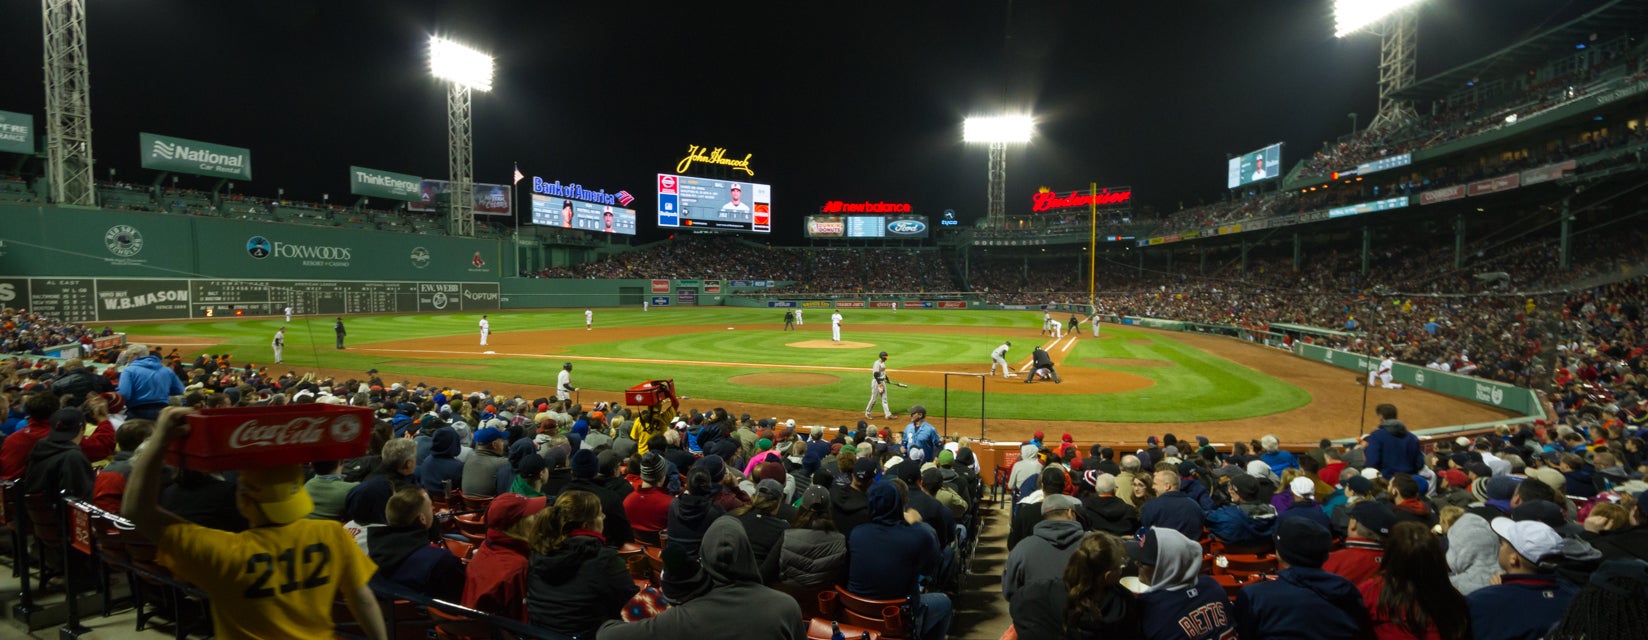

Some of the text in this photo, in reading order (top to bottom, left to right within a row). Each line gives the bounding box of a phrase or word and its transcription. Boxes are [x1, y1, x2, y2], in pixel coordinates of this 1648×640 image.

[174, 145, 242, 167] National
[676, 144, 755, 177] John Hancock
[199, 163, 241, 174] Car Rental
[356, 171, 419, 192] ThinkEnergy
[533, 176, 616, 206] Bank of America
[843, 203, 864, 213] new
[865, 201, 912, 213] balance
[1032, 188, 1132, 212] Budweiser
[895, 221, 918, 232] Ford
[274, 242, 352, 260] FOXWOODS
[436, 284, 459, 293] WEBB
[472, 292, 498, 301] OPTUM
[229, 416, 330, 448] Coca-Cola
[245, 542, 331, 599] 212
[1178, 601, 1229, 640] BETTS
